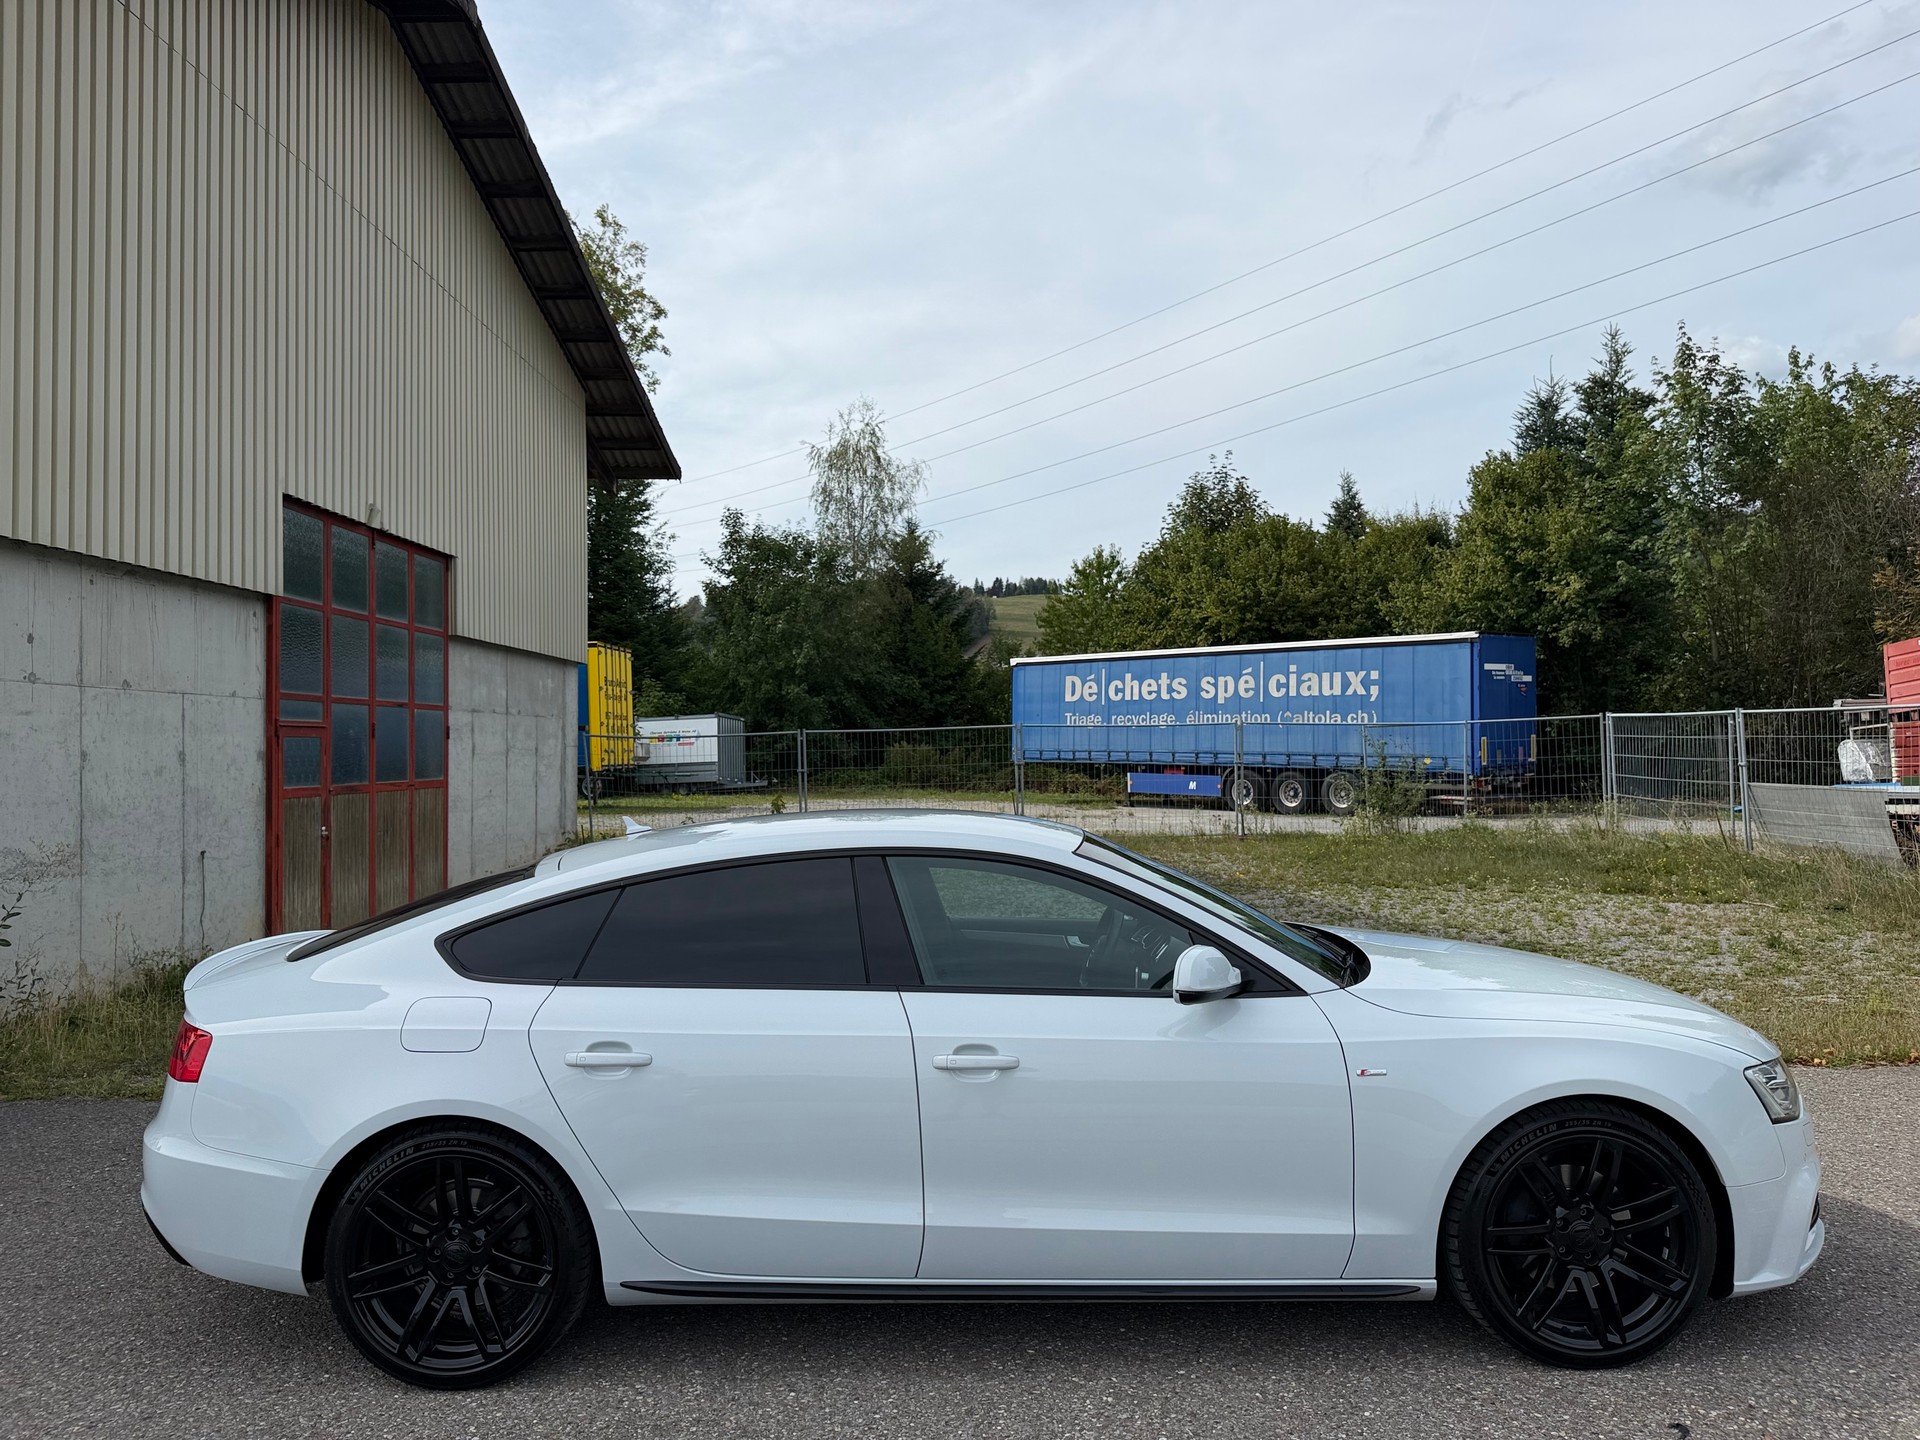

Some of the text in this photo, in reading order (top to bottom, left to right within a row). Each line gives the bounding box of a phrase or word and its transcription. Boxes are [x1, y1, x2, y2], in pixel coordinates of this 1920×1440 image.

[1186, 710, 1271, 725] élimination
[1500, 1123, 1557, 1163] MICHELIN
[359, 1146, 415, 1190] MICHELIN
